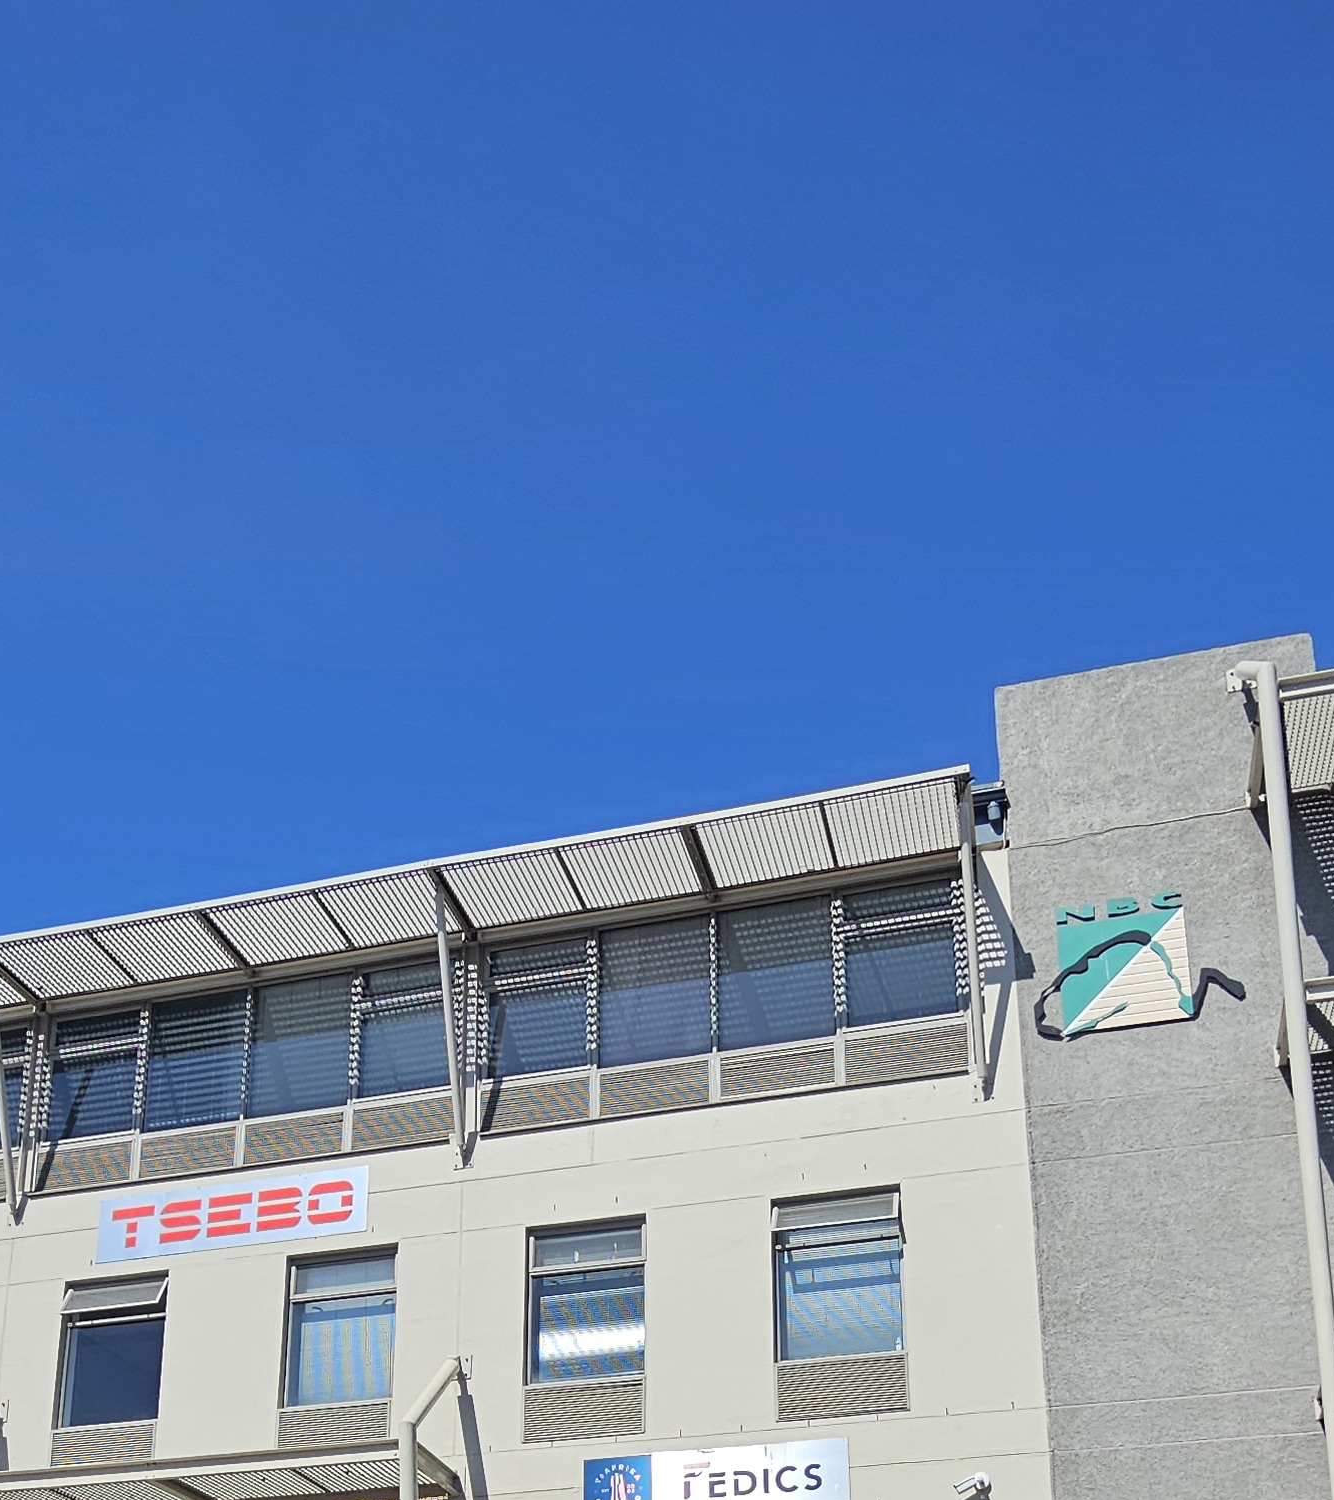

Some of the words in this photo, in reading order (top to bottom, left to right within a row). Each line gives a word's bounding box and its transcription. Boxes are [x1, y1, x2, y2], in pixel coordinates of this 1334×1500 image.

[1057, 889, 1183, 925] NBC
[112, 1181, 354, 1248] TSEBO
[683, 1462, 823, 1500] FEDICS
